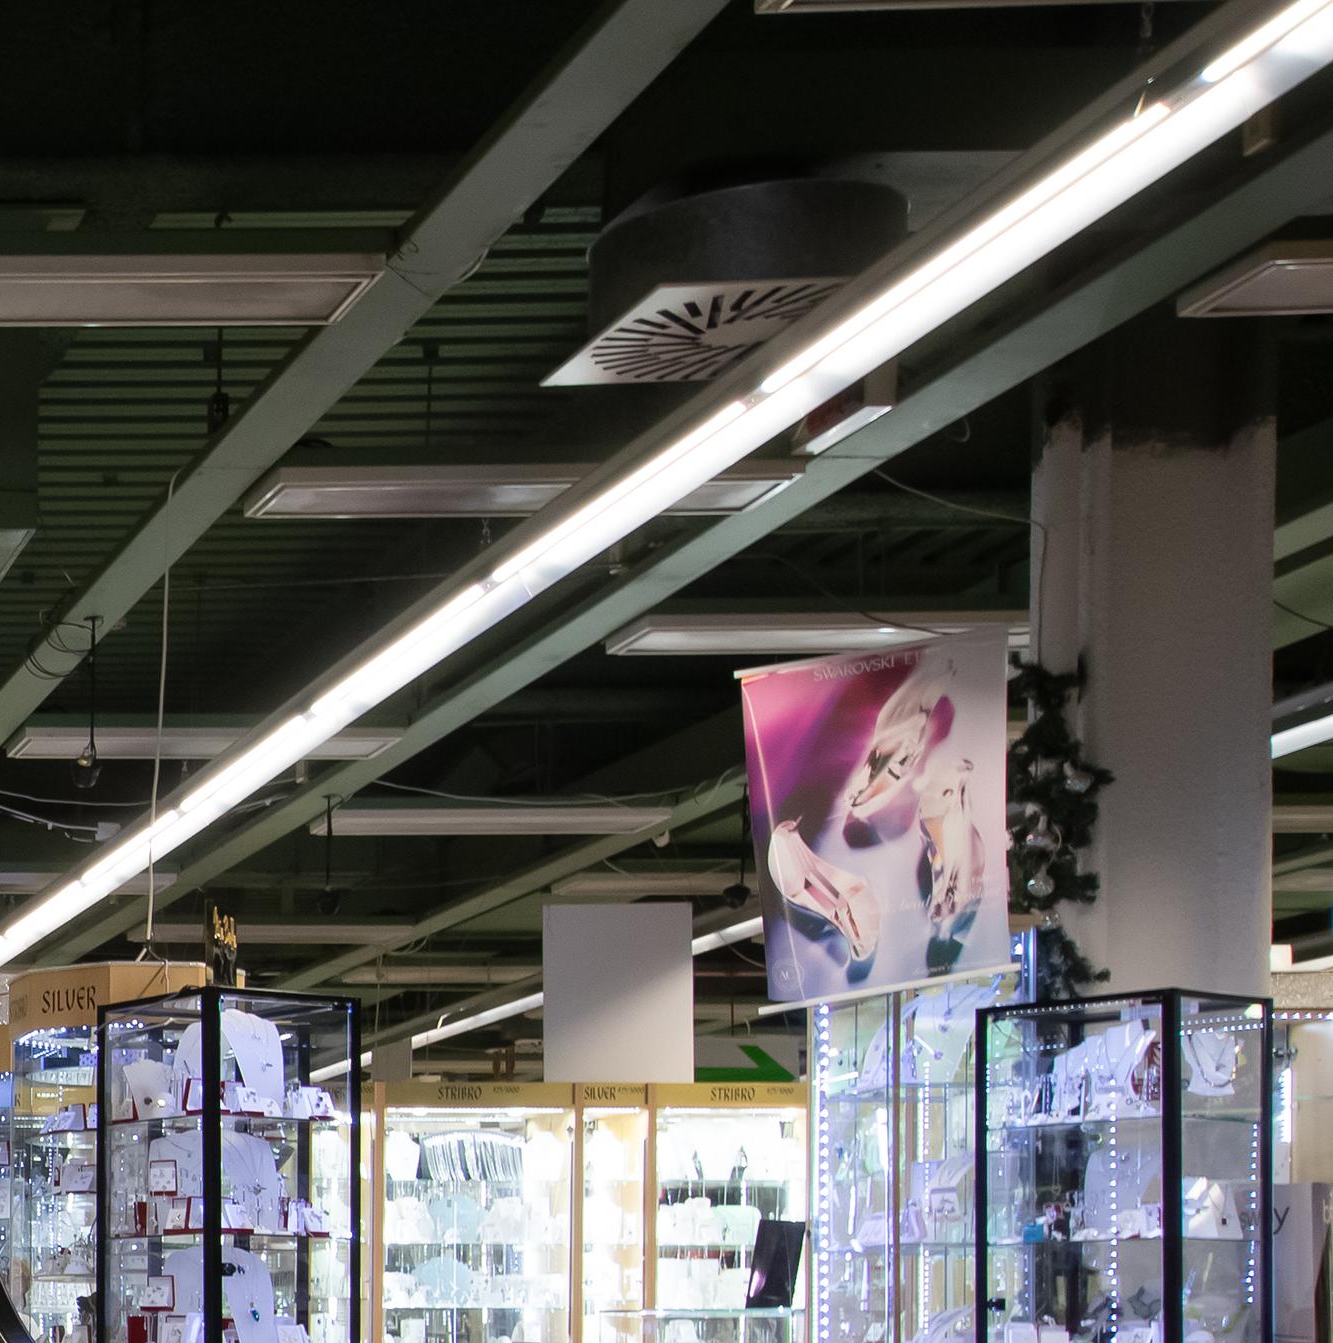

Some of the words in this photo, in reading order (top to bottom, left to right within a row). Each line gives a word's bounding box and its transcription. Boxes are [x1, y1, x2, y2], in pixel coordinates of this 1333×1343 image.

[813, 655, 895, 682] SWAROVSKI
[41, 985, 97, 1014] SILVER
[583, 1086, 617, 1101] SILVER
